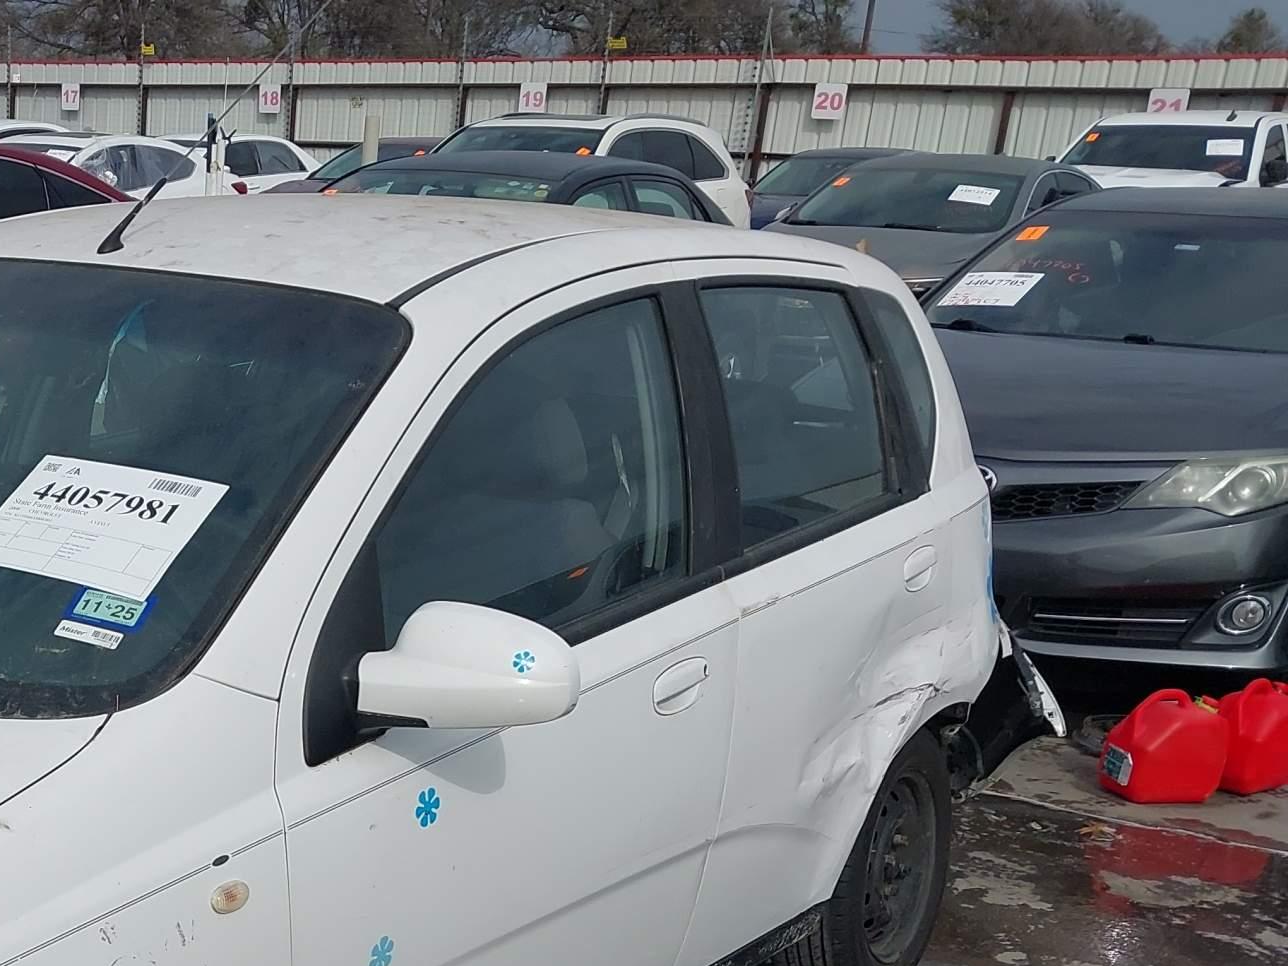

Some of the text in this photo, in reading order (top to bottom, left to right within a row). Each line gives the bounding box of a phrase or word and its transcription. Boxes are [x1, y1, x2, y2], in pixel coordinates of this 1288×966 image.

[63, 89, 78, 103] 17
[261, 91, 279, 106] 18
[522, 90, 544, 107] 19
[814, 92, 844, 111] 20
[33, 481, 181, 525] 44057981
[53, 505, 89, 517] Insurance
